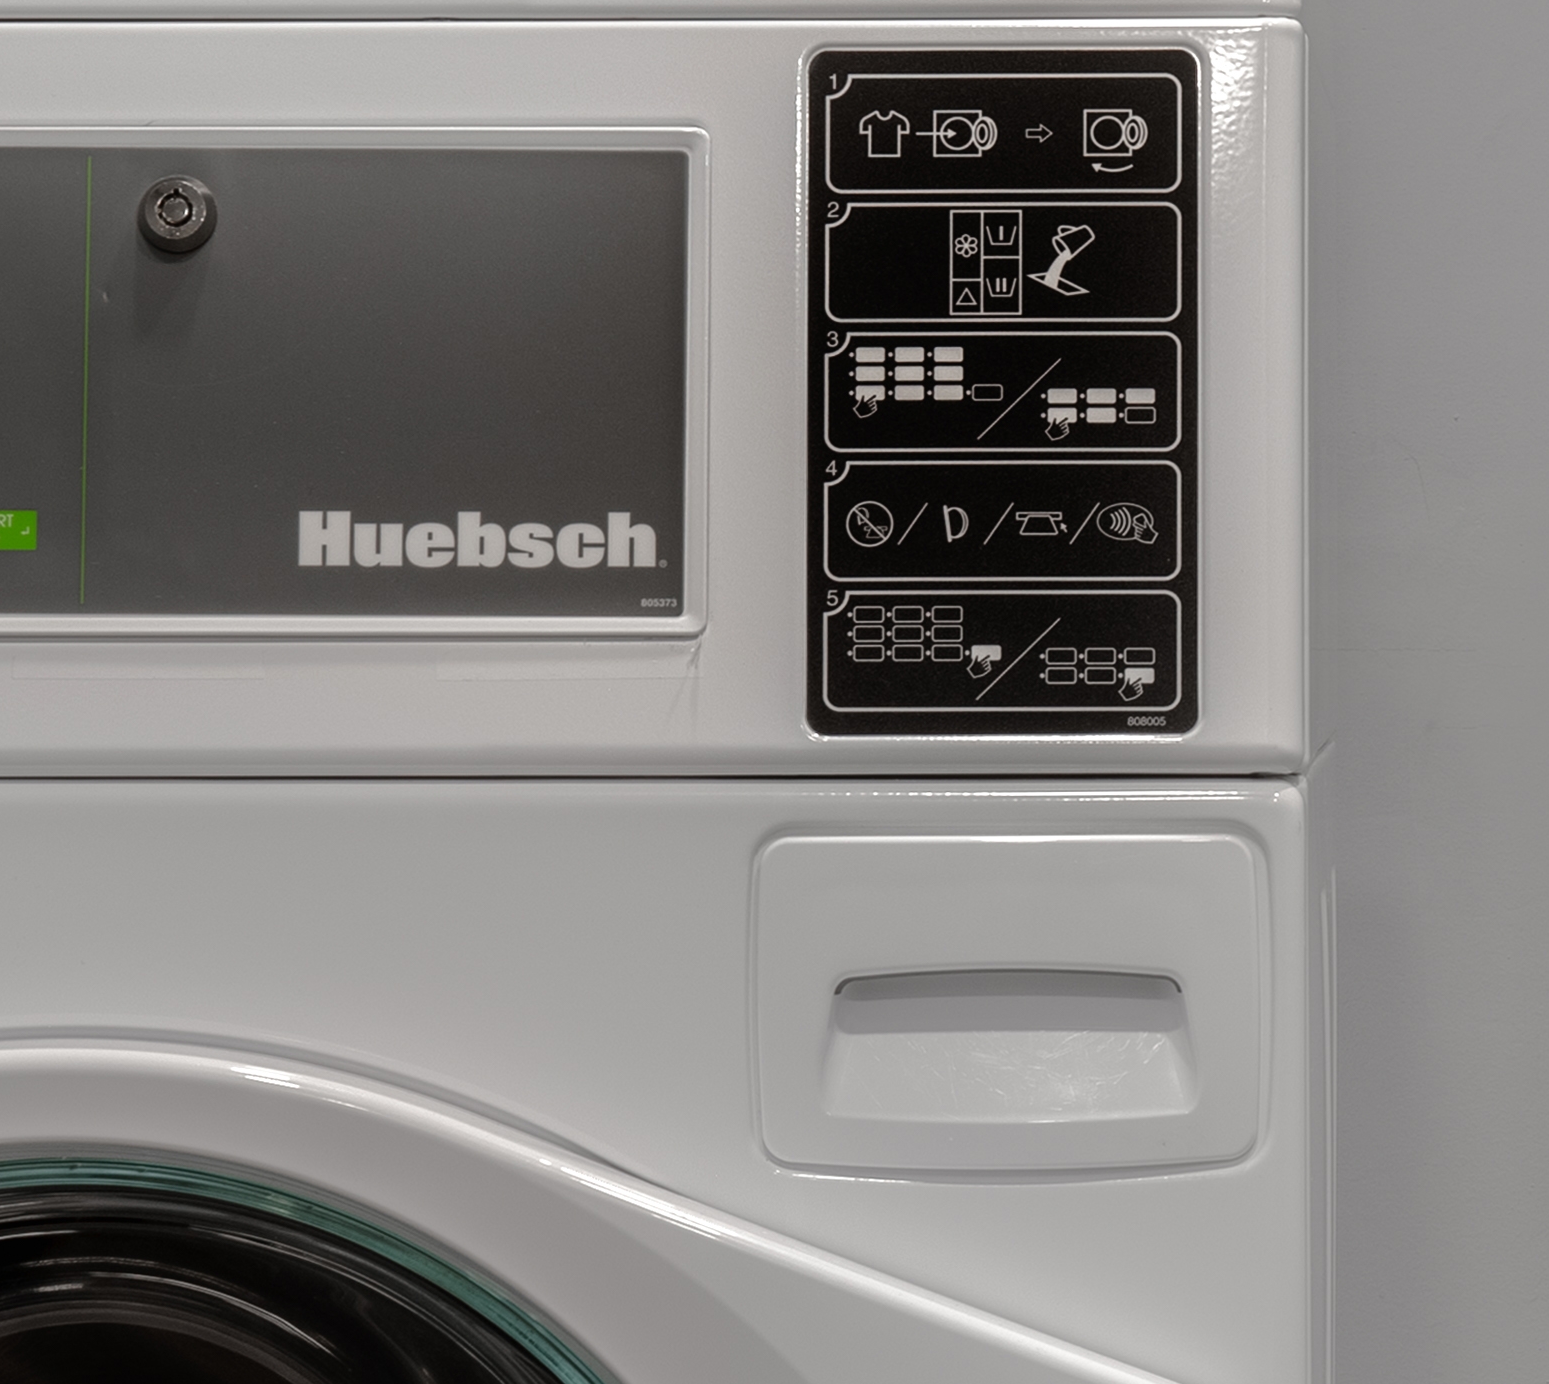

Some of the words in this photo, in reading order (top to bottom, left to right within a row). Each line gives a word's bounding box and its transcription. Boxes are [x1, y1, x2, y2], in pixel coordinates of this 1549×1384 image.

[829, 73, 838, 90] 1
[826, 202, 840, 218] 2
[826, 331, 839, 348] 3
[825, 461, 838, 476] 4
[298, 510, 657, 569] Huebsch
[826, 590, 839, 606] 5
